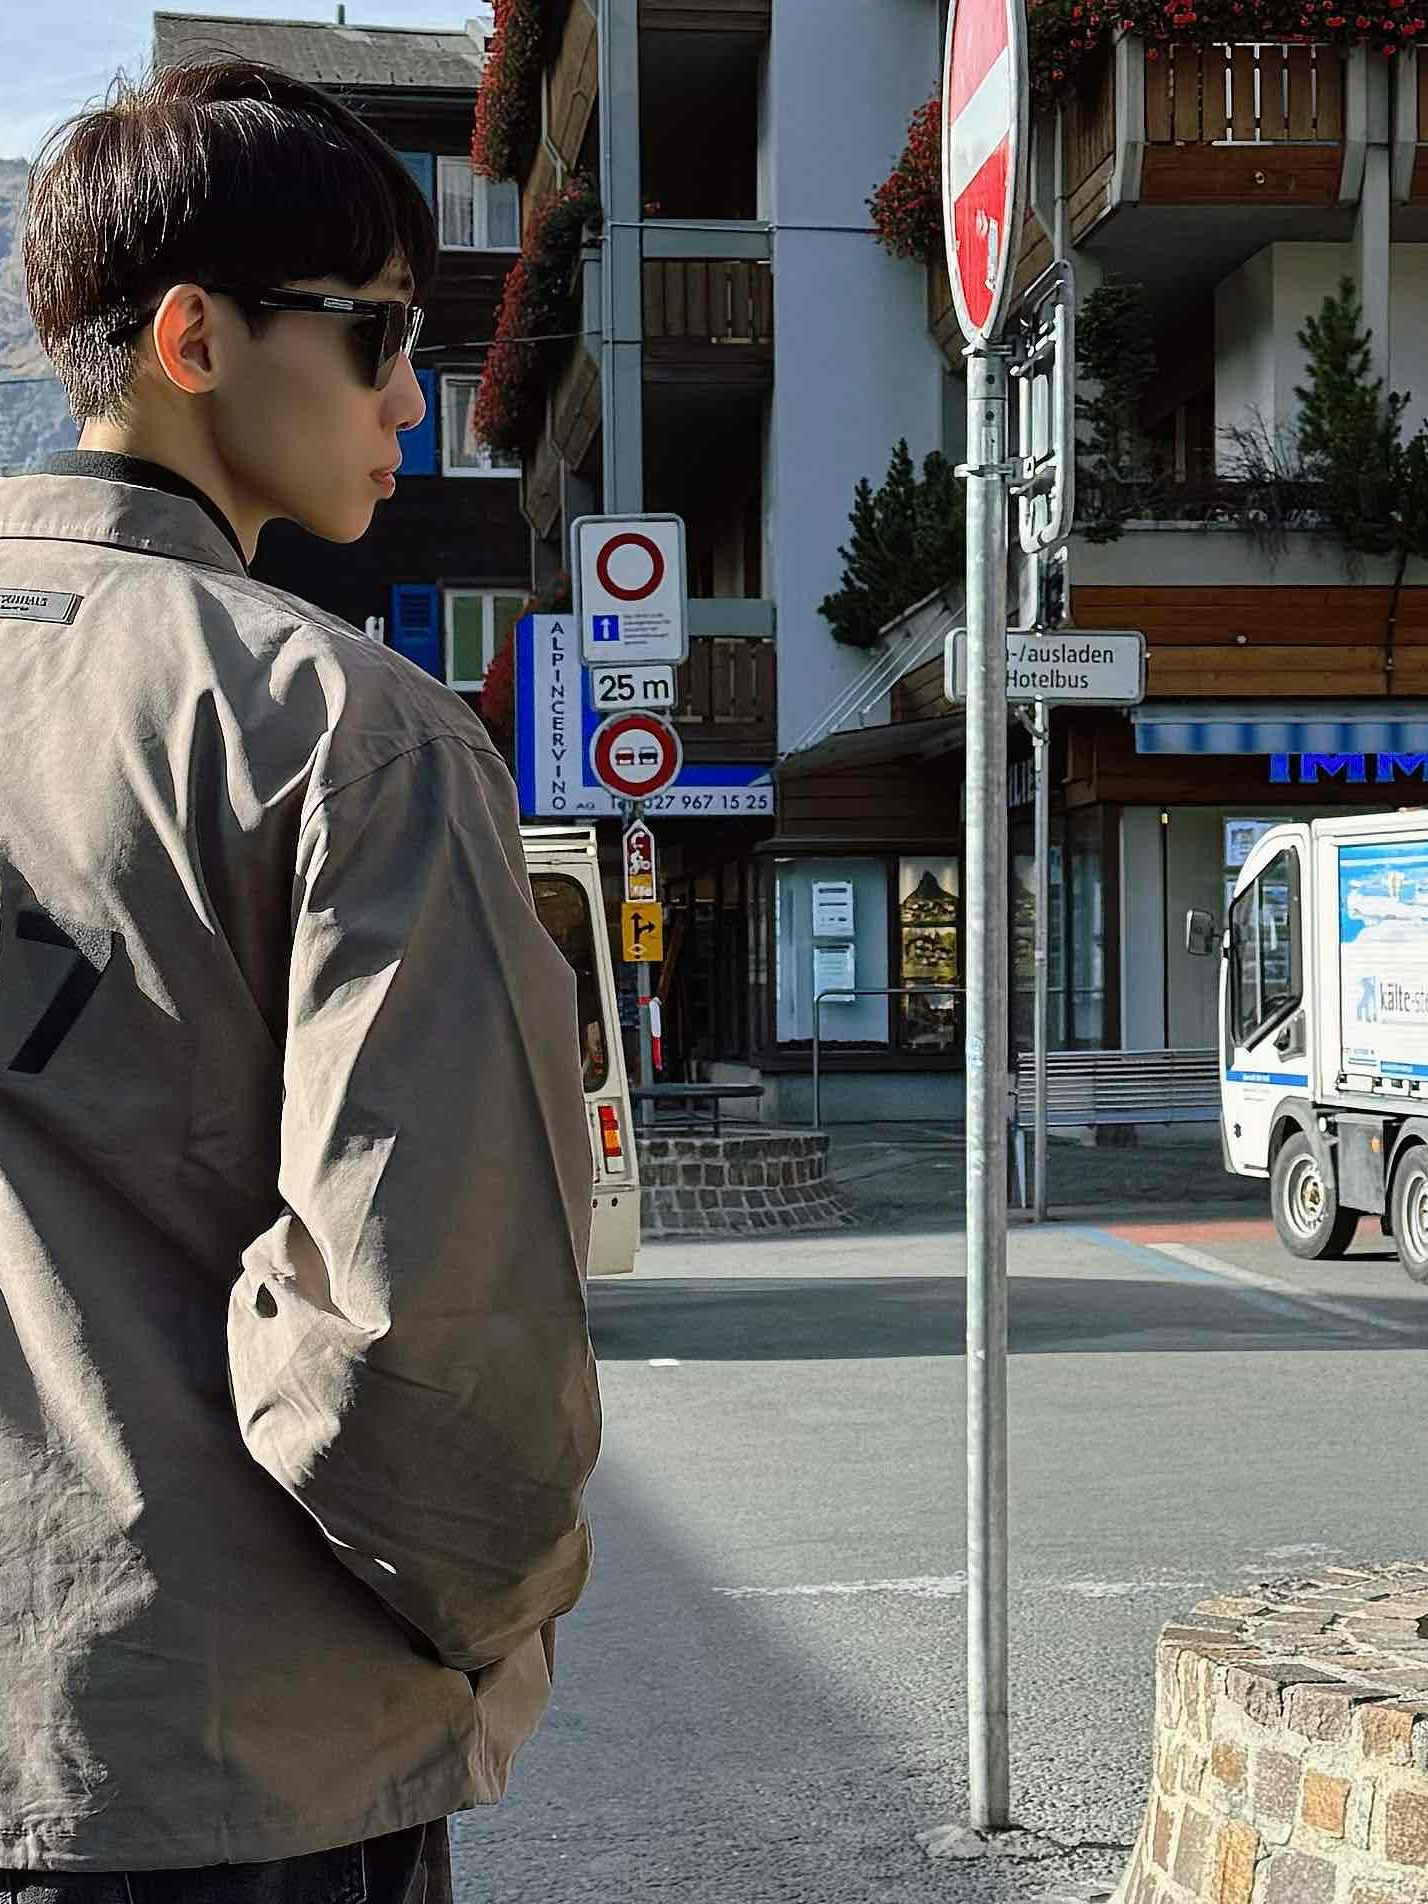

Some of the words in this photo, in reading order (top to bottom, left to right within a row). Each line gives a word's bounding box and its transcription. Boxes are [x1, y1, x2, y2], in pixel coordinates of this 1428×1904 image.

[1006, 643, 1114, 664] -/ausladen
[598, 674, 635, 702] 25
[642, 679, 670, 699] m
[1006, 669, 1089, 689] Hotelbus
[550, 621, 567, 811] ALPINCERVINO
[681, 795, 714, 810] 967
[722, 795, 740, 810] 15
[745, 795, 768, 810] 25
